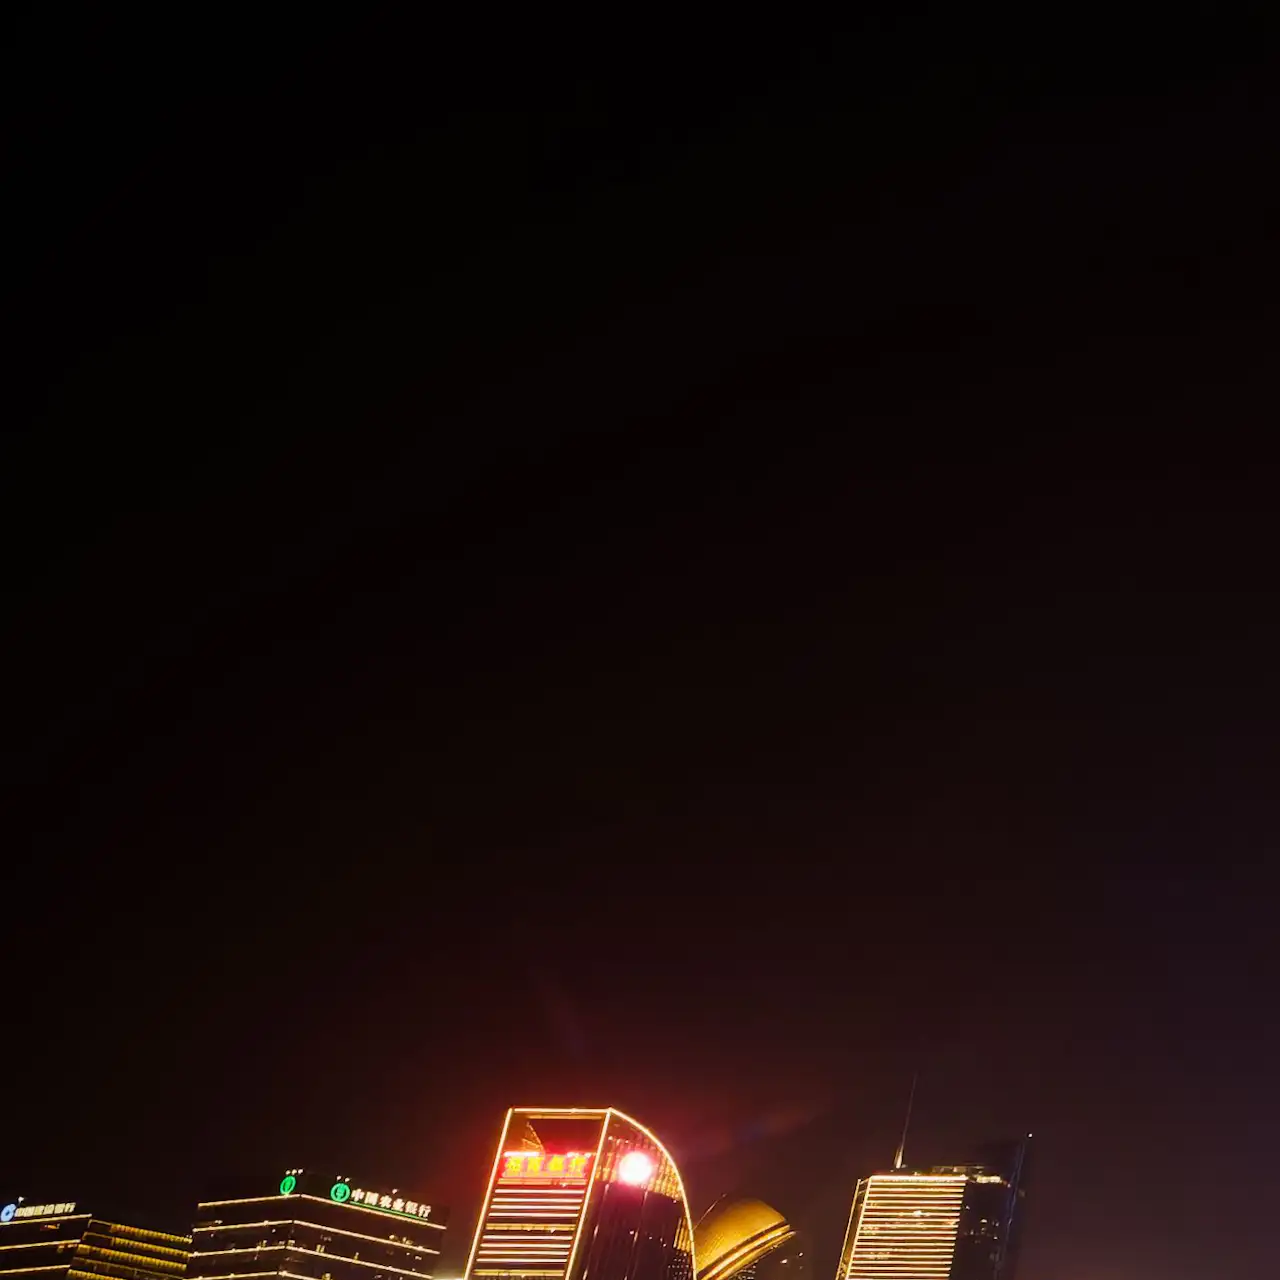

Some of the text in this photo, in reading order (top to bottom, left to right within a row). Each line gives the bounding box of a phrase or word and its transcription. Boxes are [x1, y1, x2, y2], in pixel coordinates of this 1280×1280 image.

[351, 1188, 432, 1218] 中国农业银行
